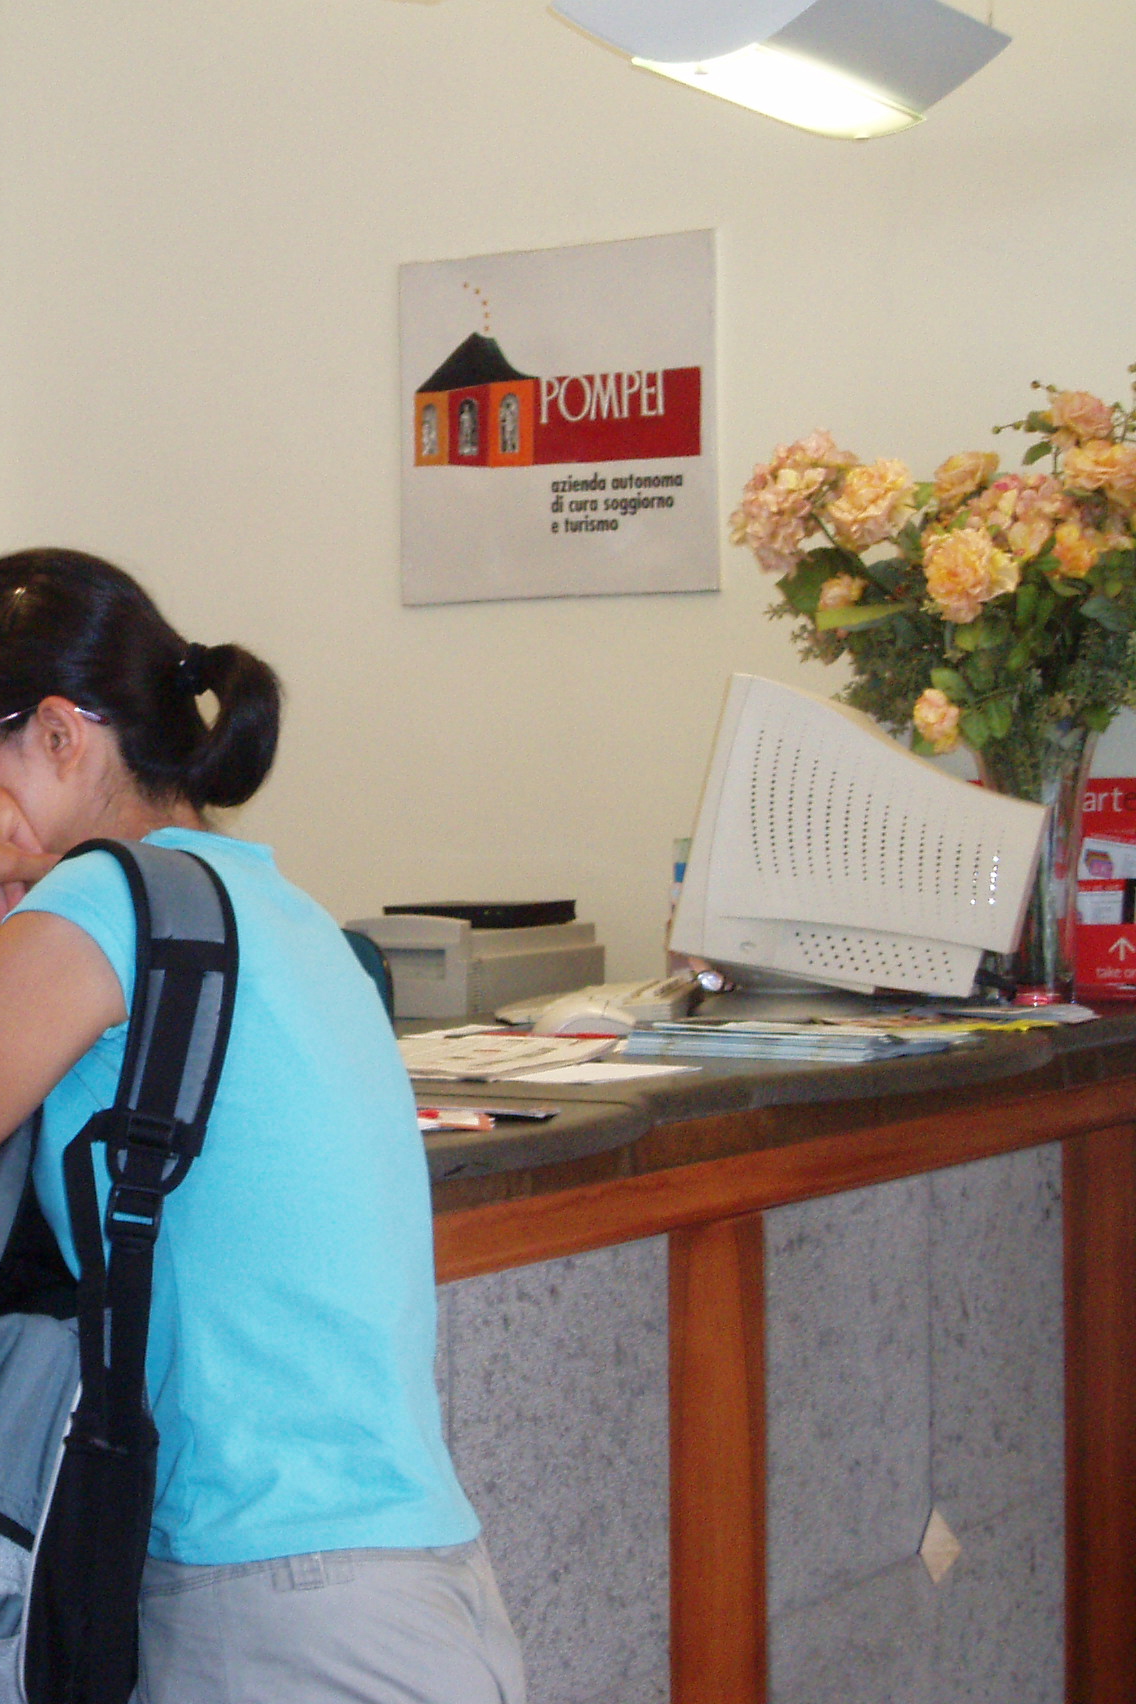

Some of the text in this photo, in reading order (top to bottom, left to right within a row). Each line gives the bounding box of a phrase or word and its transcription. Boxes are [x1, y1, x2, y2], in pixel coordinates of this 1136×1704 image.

[539, 369, 666, 425] POMPEI
[551, 472, 683, 493] azienda autonoma
[551, 491, 674, 516] di cura soggiorno
[550, 514, 619, 533] e turismo
